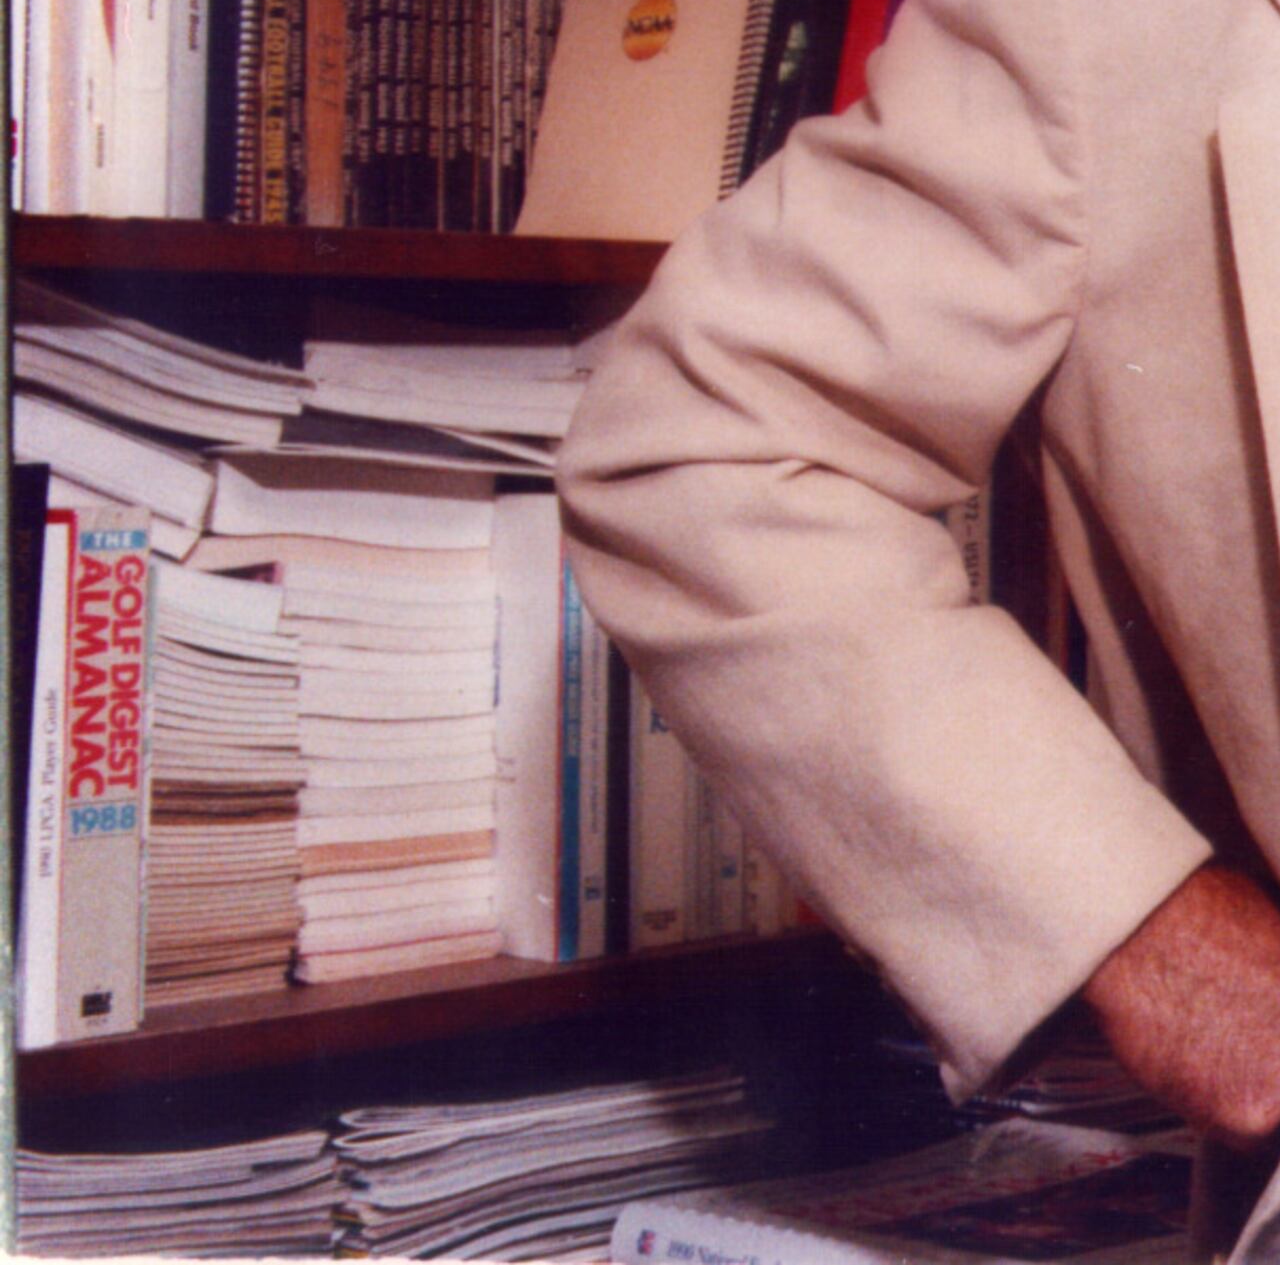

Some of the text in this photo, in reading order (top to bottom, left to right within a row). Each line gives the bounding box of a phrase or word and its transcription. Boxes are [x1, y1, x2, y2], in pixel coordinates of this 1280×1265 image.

[625, 14, 675, 35] NCAA
[264, 19, 287, 106] FOOTBALL
[92, 531, 133, 549] THE
[69, 553, 112, 800] ALMANAC
[107, 554, 145, 791] GOLF DIGEST
[70, 803, 137, 835] 1988
